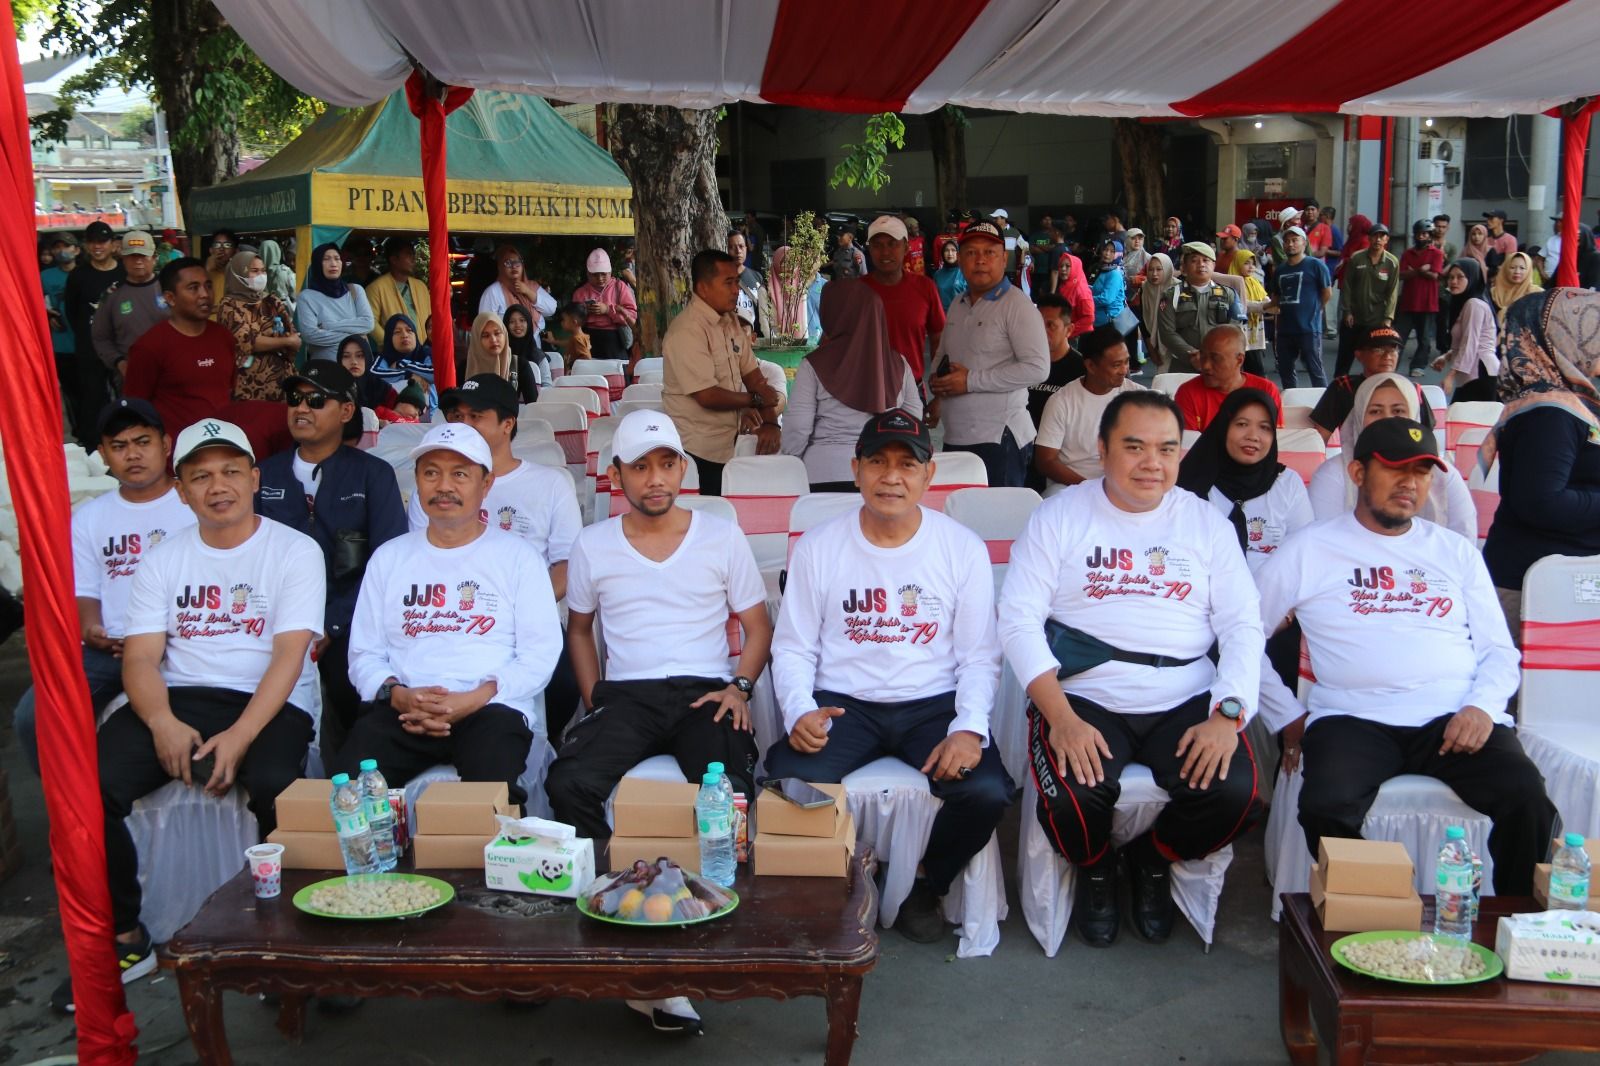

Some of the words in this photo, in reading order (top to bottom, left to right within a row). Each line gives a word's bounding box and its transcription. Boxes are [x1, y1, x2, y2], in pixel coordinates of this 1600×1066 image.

[348, 187, 424, 212] PT.BAN
[447, 192, 499, 215] BPRS
[504, 194, 582, 217] BHAKTI
[103, 533, 141, 557] JJS
[1086, 545, 1133, 571] JJS
[1347, 565, 1395, 590] JJS
[176, 584, 221, 610] JJS
[402, 583, 446, 608] JJS
[842, 587, 887, 614] JJS
